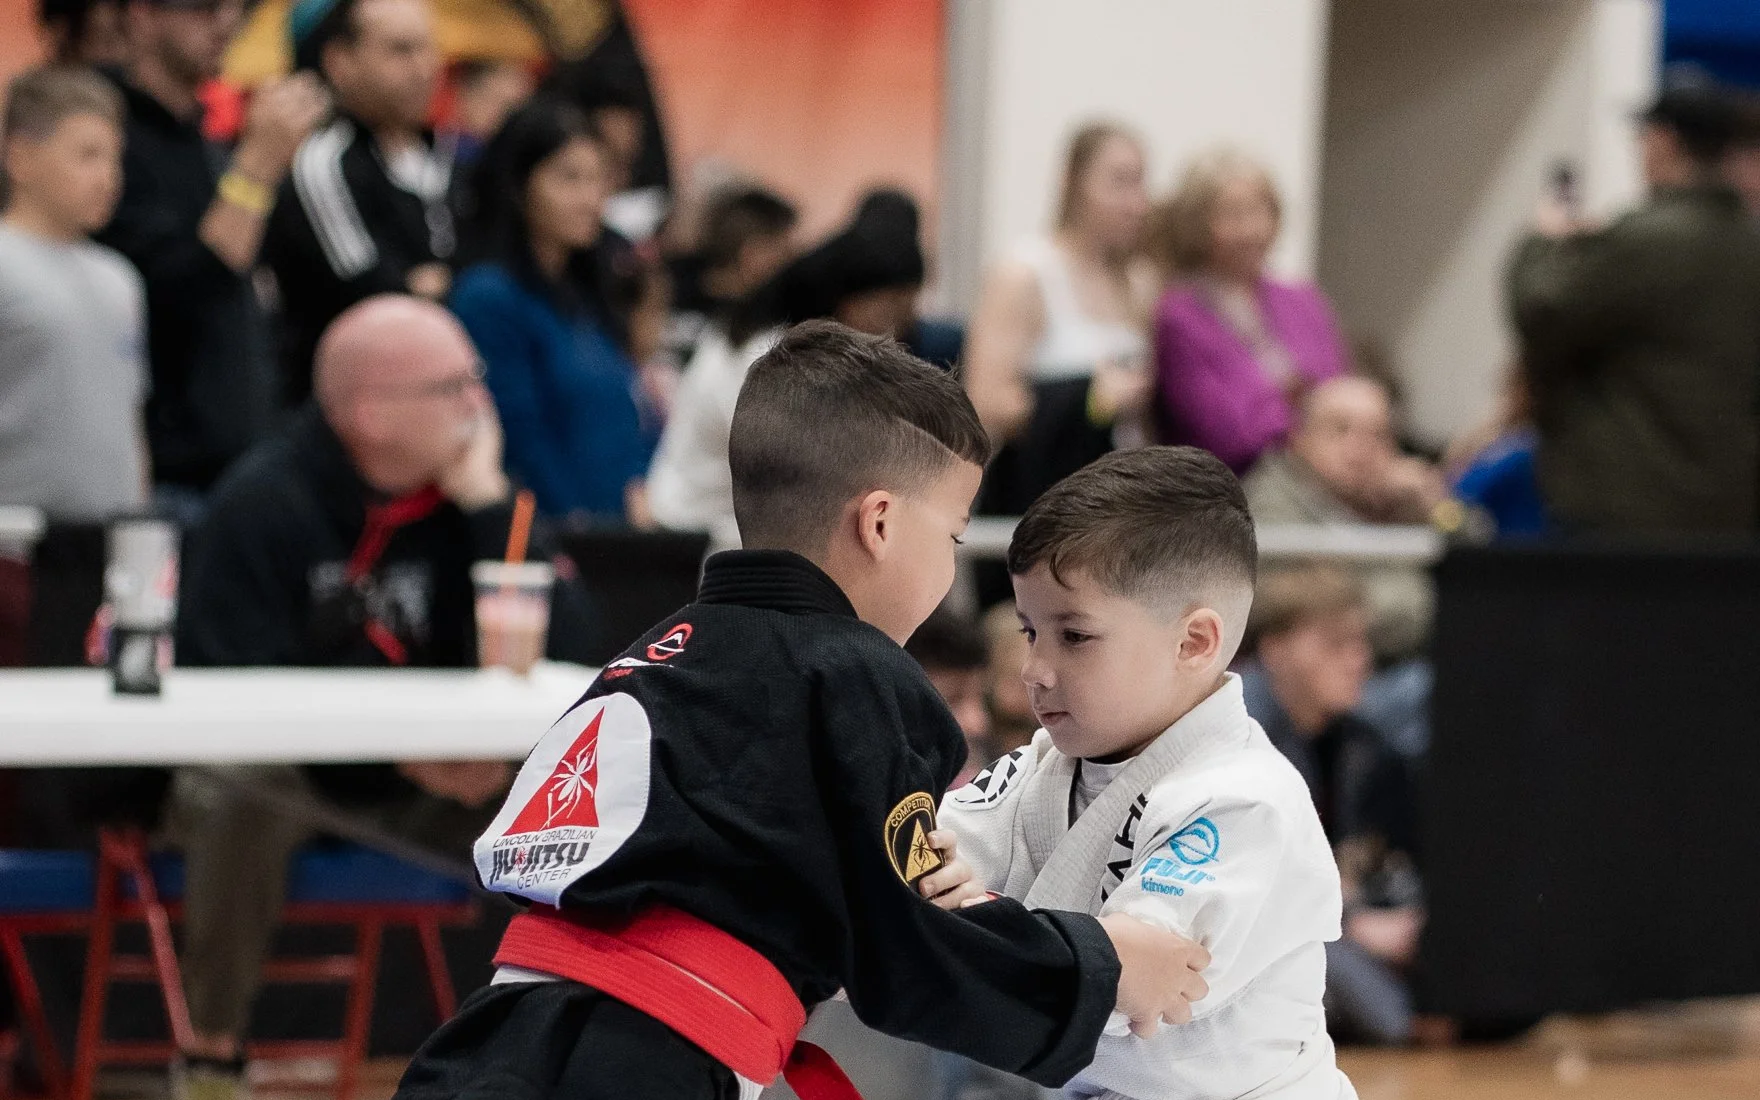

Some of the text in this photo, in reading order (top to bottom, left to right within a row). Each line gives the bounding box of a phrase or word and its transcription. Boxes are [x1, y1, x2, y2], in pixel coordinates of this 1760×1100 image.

[493, 829, 597, 848] LINCOLN BRAZILIAN
[517, 868, 571, 889] CENTER
[1141, 876, 1185, 898] kimono
